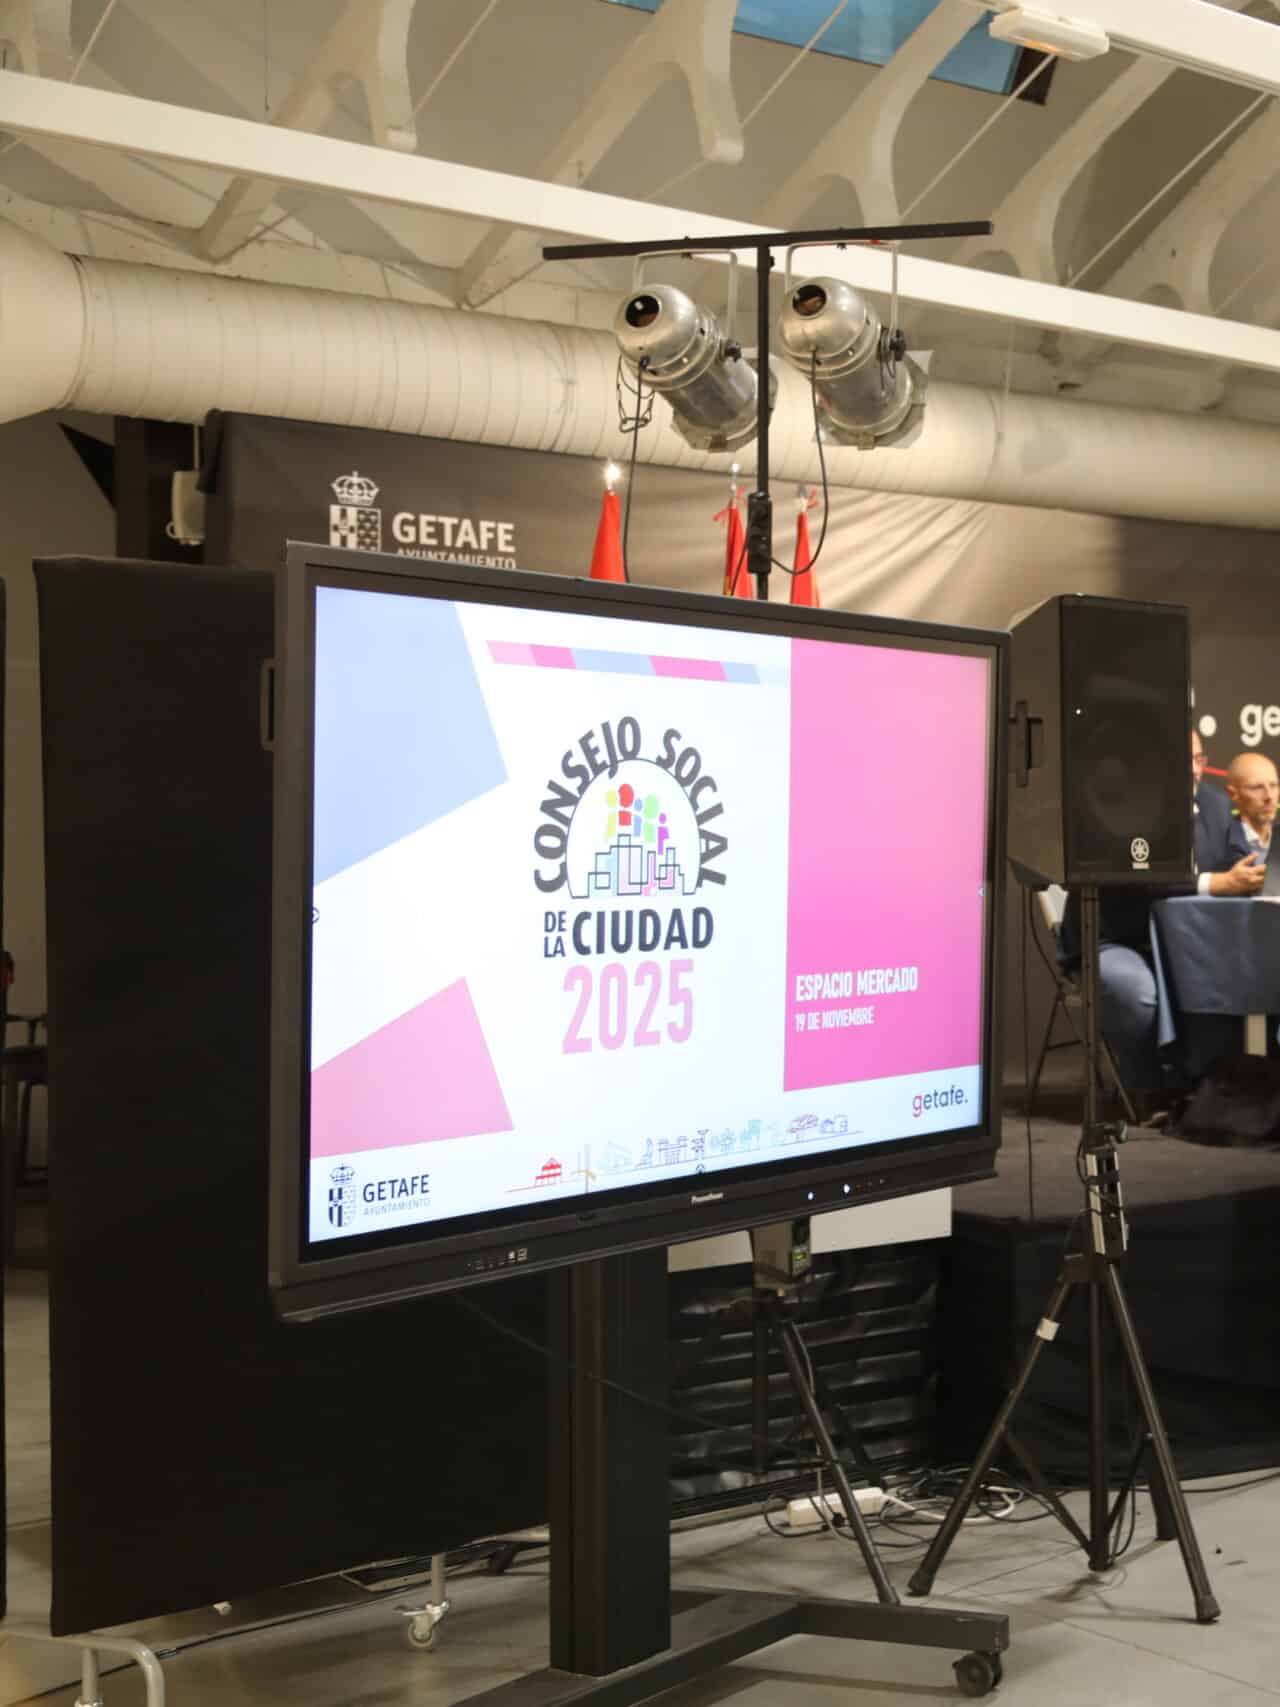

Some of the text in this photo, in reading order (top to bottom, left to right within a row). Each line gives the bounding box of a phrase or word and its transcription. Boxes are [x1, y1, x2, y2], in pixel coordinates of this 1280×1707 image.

[392, 511, 516, 553] GETAFE
[534, 716, 728, 893] CONSEJO SOCIAL
[544, 906, 714, 958] DE LA CIUDAD
[796, 966, 919, 1002] ESPACIO MERCADO
[562, 958, 695, 1055] 2025
[795, 1006, 876, 1033] 19 DE NOVIEMBRE
[912, 1084, 969, 1118] getafe.
[363, 1174, 430, 1203] GETAFE
